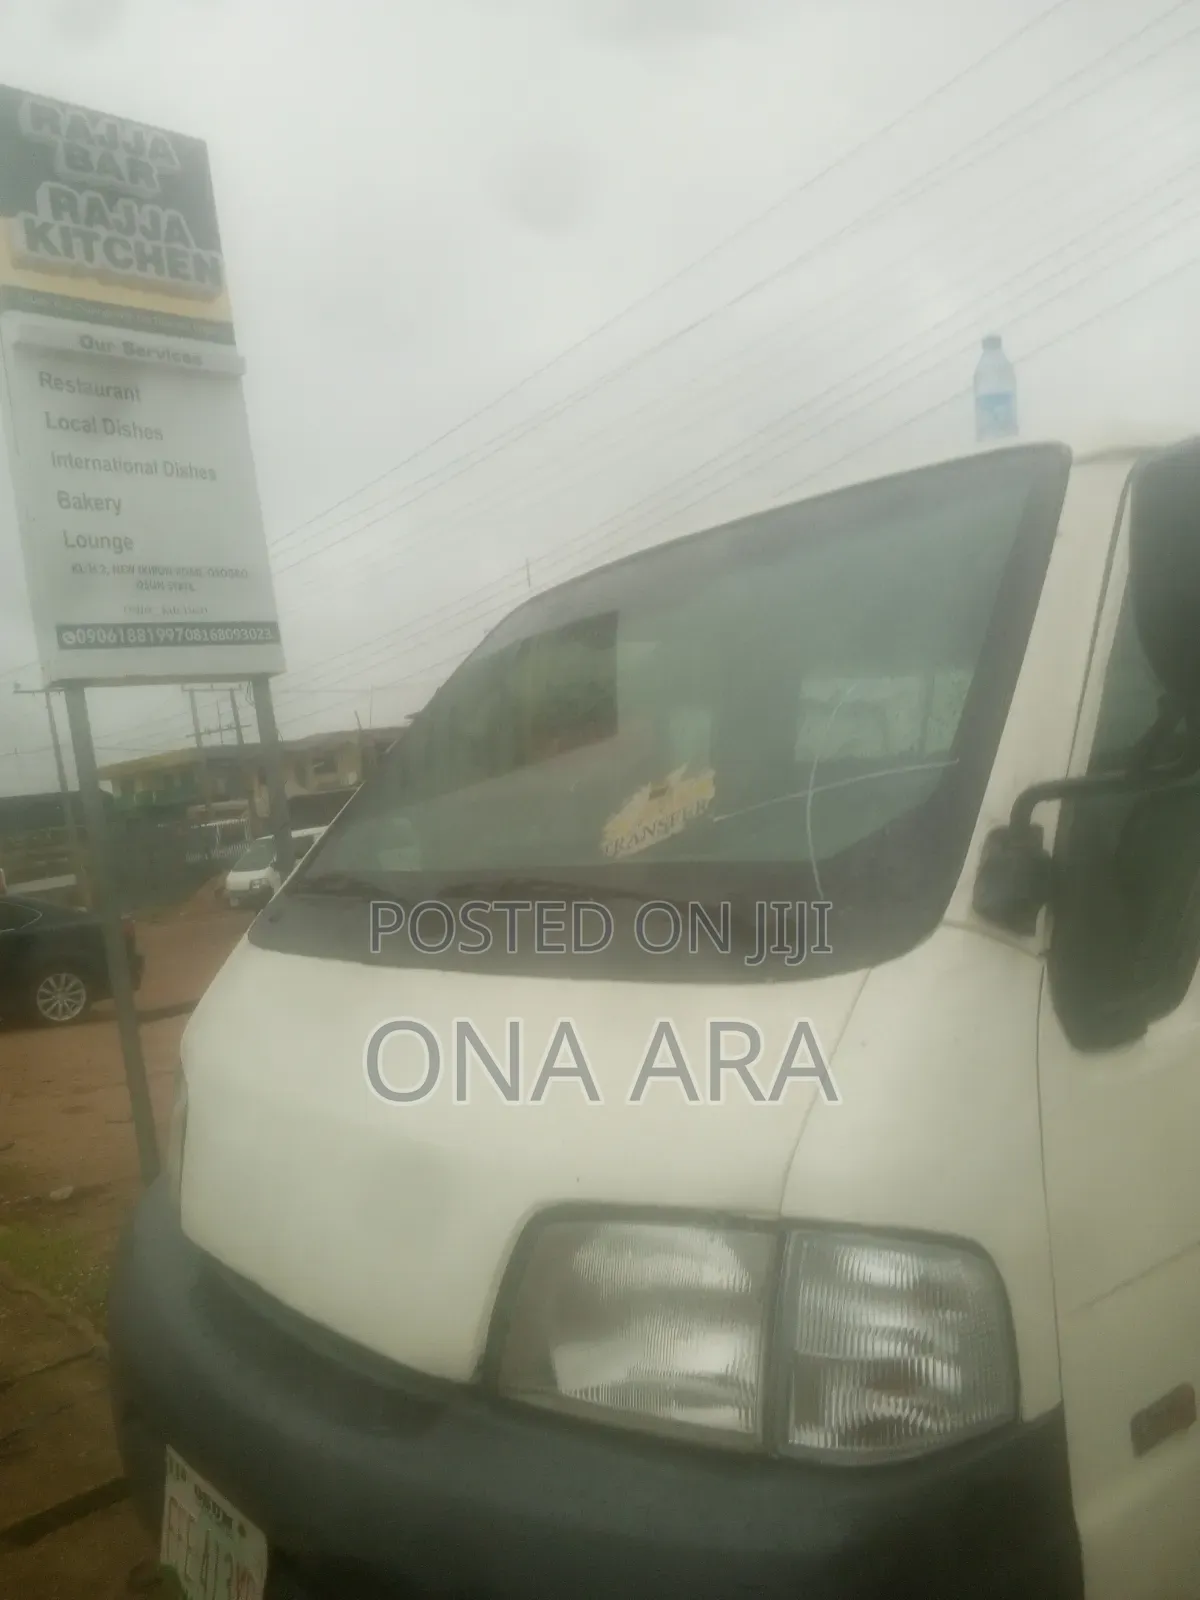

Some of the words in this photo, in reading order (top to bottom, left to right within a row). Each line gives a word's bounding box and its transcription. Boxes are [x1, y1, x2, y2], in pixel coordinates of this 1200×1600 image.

[38, 184, 197, 252] RAJJA
[19, 211, 222, 292] KITCHEN
[79, 333, 115, 353] Our
[122, 340, 203, 366] Services
[39, 370, 142, 402] Restaurant
[44, 411, 98, 434] Local
[101, 417, 164, 441] Dishes
[51, 450, 158, 476] International
[163, 459, 218, 482] Dishes
[57, 489, 122, 516] Bakery
[62, 528, 135, 555] Lounge
